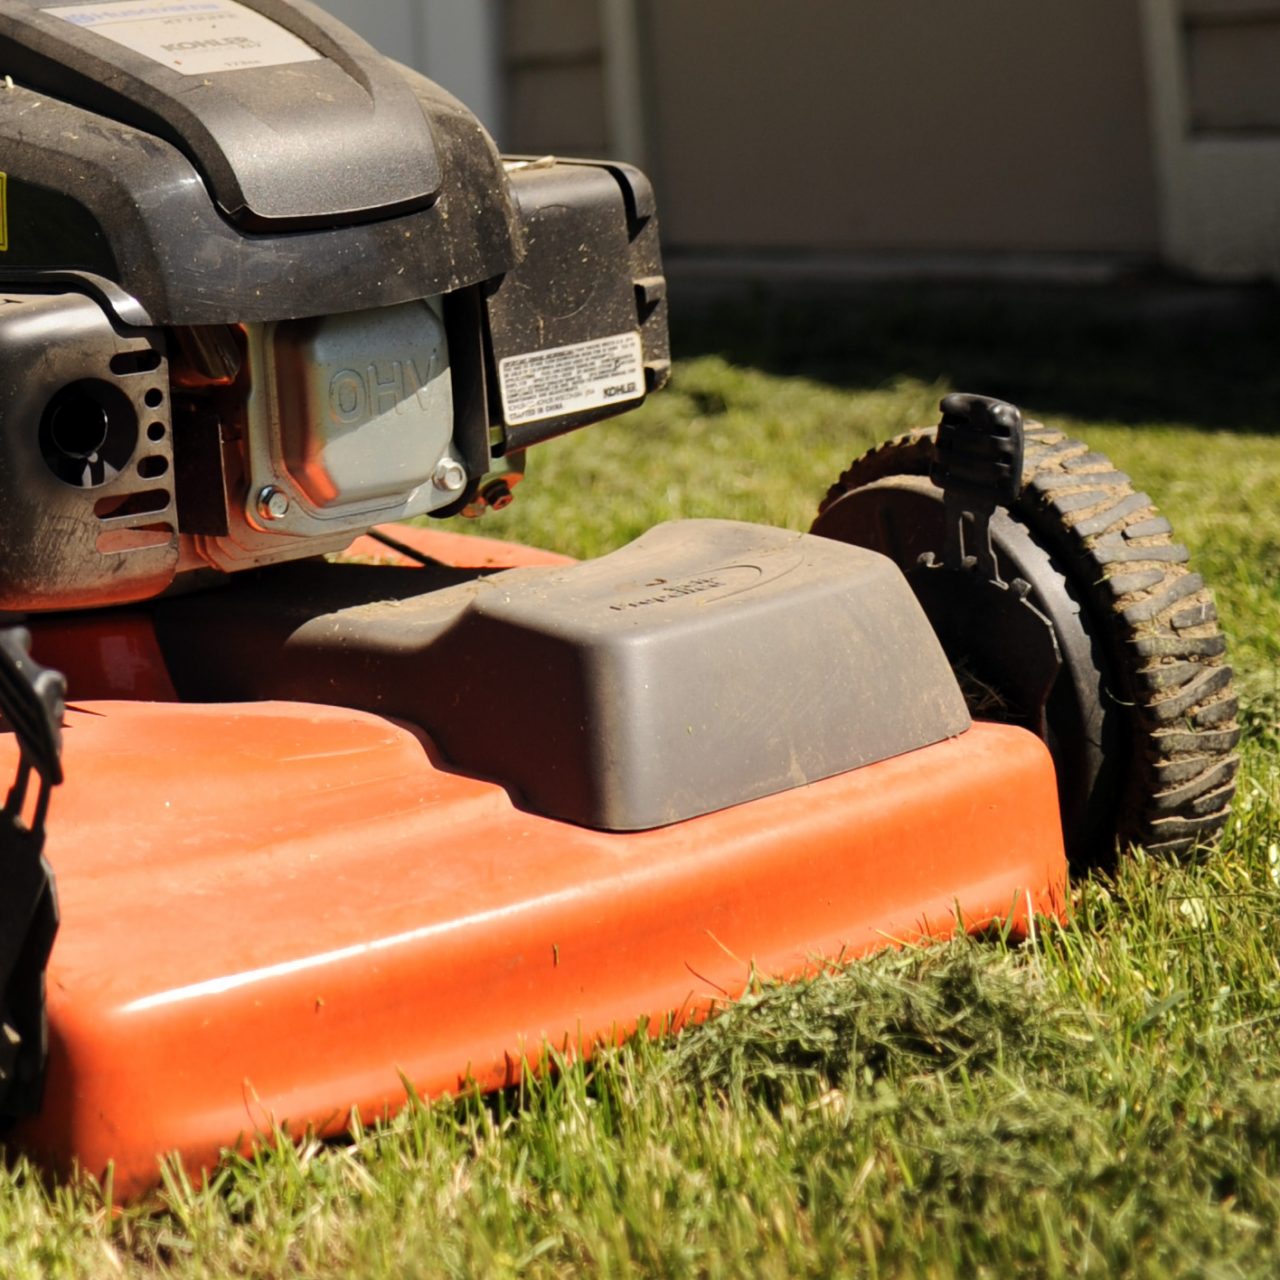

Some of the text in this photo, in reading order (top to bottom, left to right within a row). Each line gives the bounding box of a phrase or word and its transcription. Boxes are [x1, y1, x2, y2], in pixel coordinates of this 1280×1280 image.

[160, 36, 249, 52] KOHLER
[329, 354, 438, 424] OHV
[603, 382, 636, 398] KOHLER
